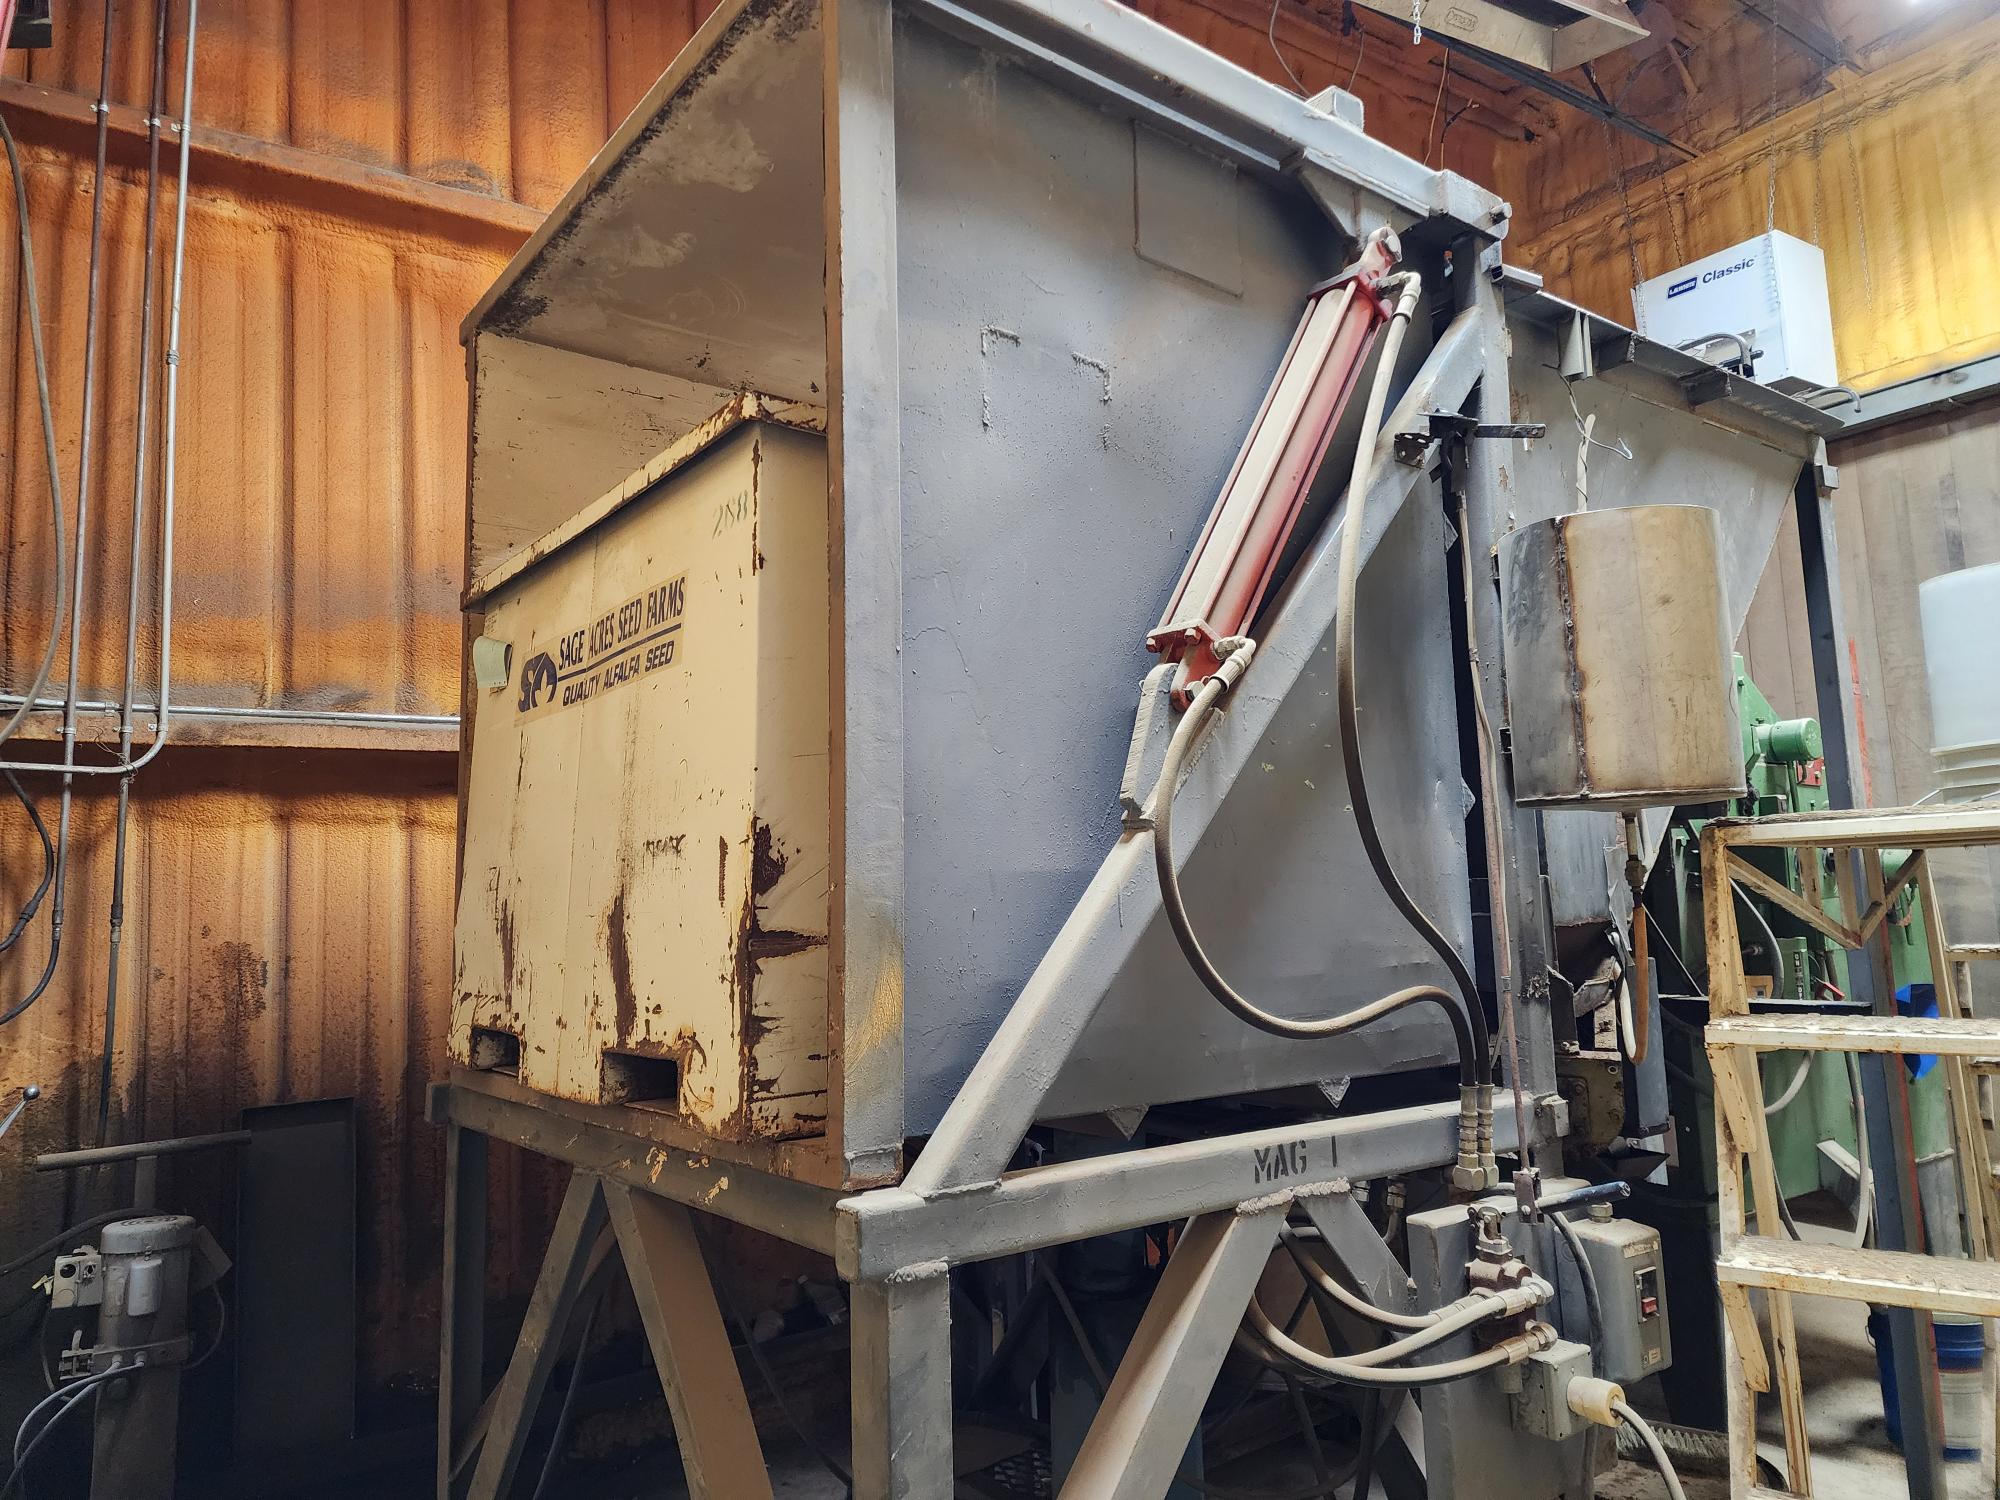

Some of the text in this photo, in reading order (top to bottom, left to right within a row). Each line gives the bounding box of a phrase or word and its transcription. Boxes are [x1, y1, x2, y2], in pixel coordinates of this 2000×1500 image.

[1702, 258, 1755, 284] Classic
[559, 576, 686, 671] SAGE ACRES SEED FARMS
[563, 640, 675, 707] QUALITY ALFALFA SEED
[1253, 1139, 1308, 1184] MAG
